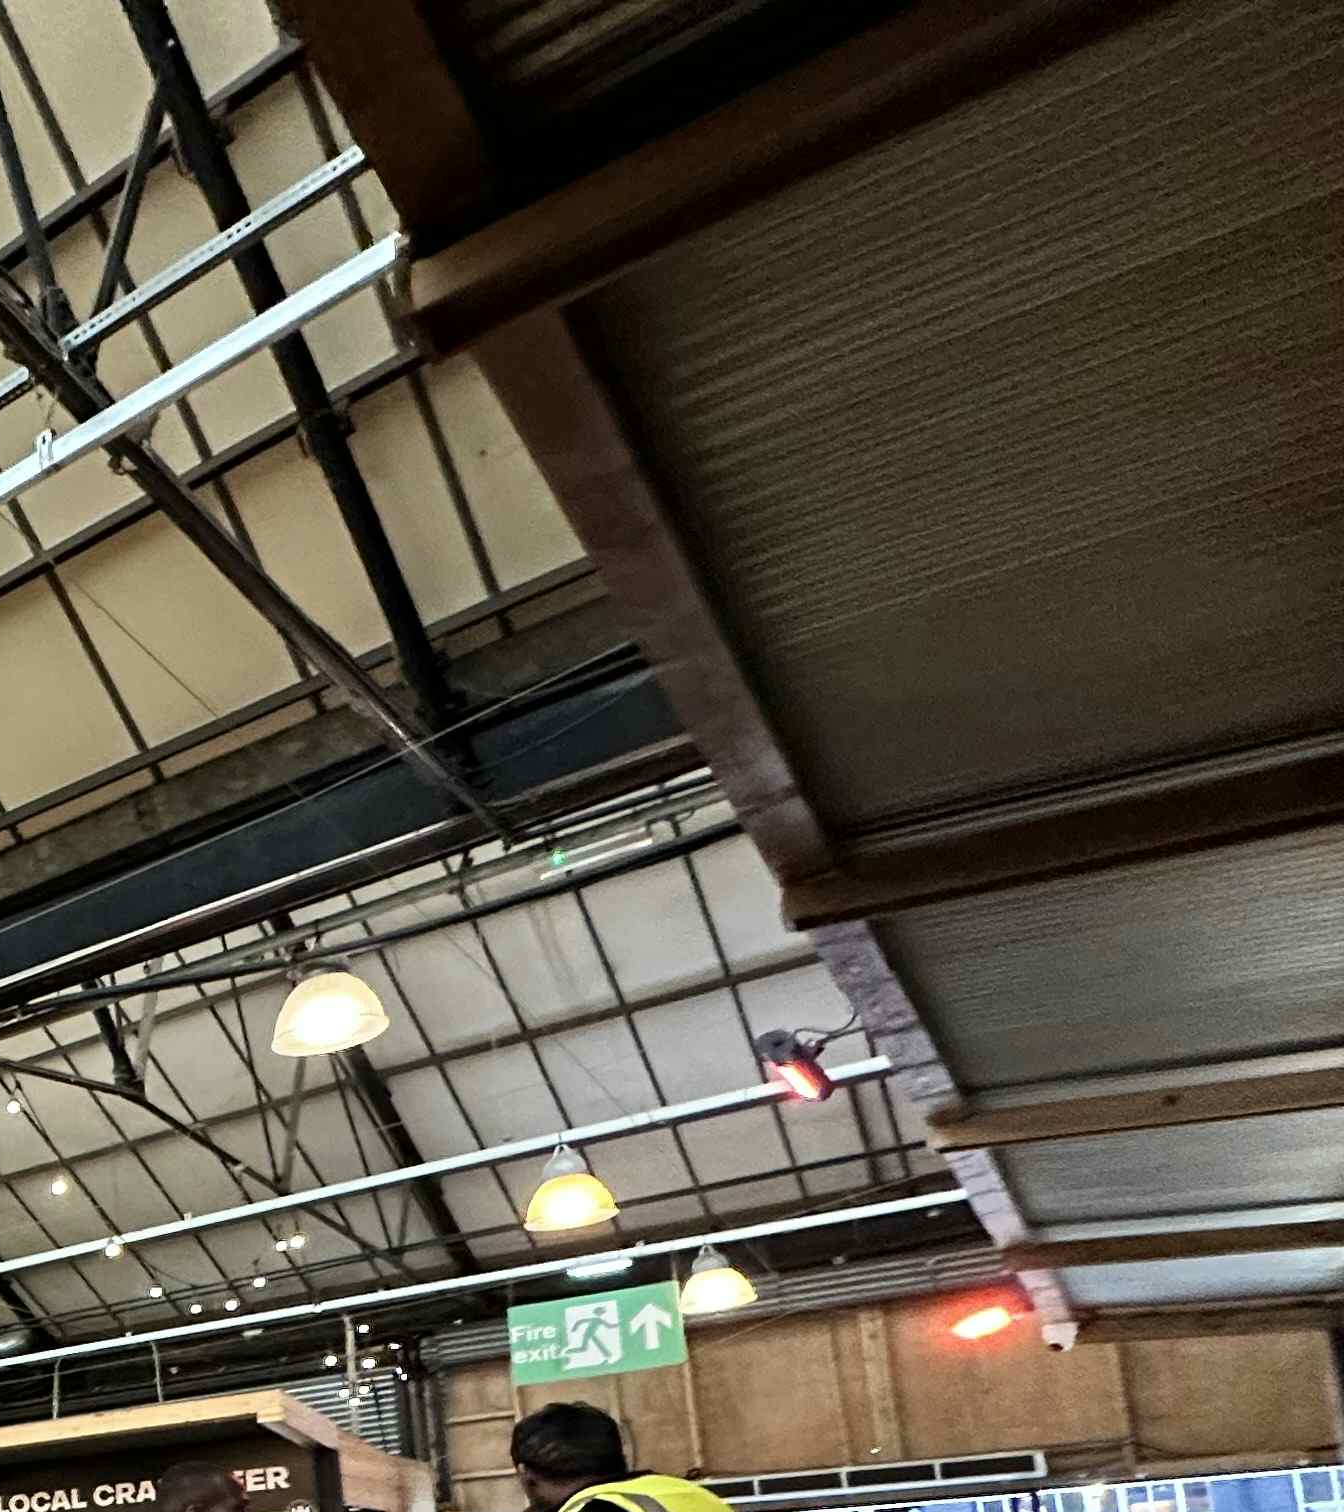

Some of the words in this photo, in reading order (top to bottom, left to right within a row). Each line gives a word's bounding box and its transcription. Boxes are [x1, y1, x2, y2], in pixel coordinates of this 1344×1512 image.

[510, 1325, 557, 1343] Fire
[513, 1342, 562, 1364] exit
[93, 1480, 160, 1507] CRA
